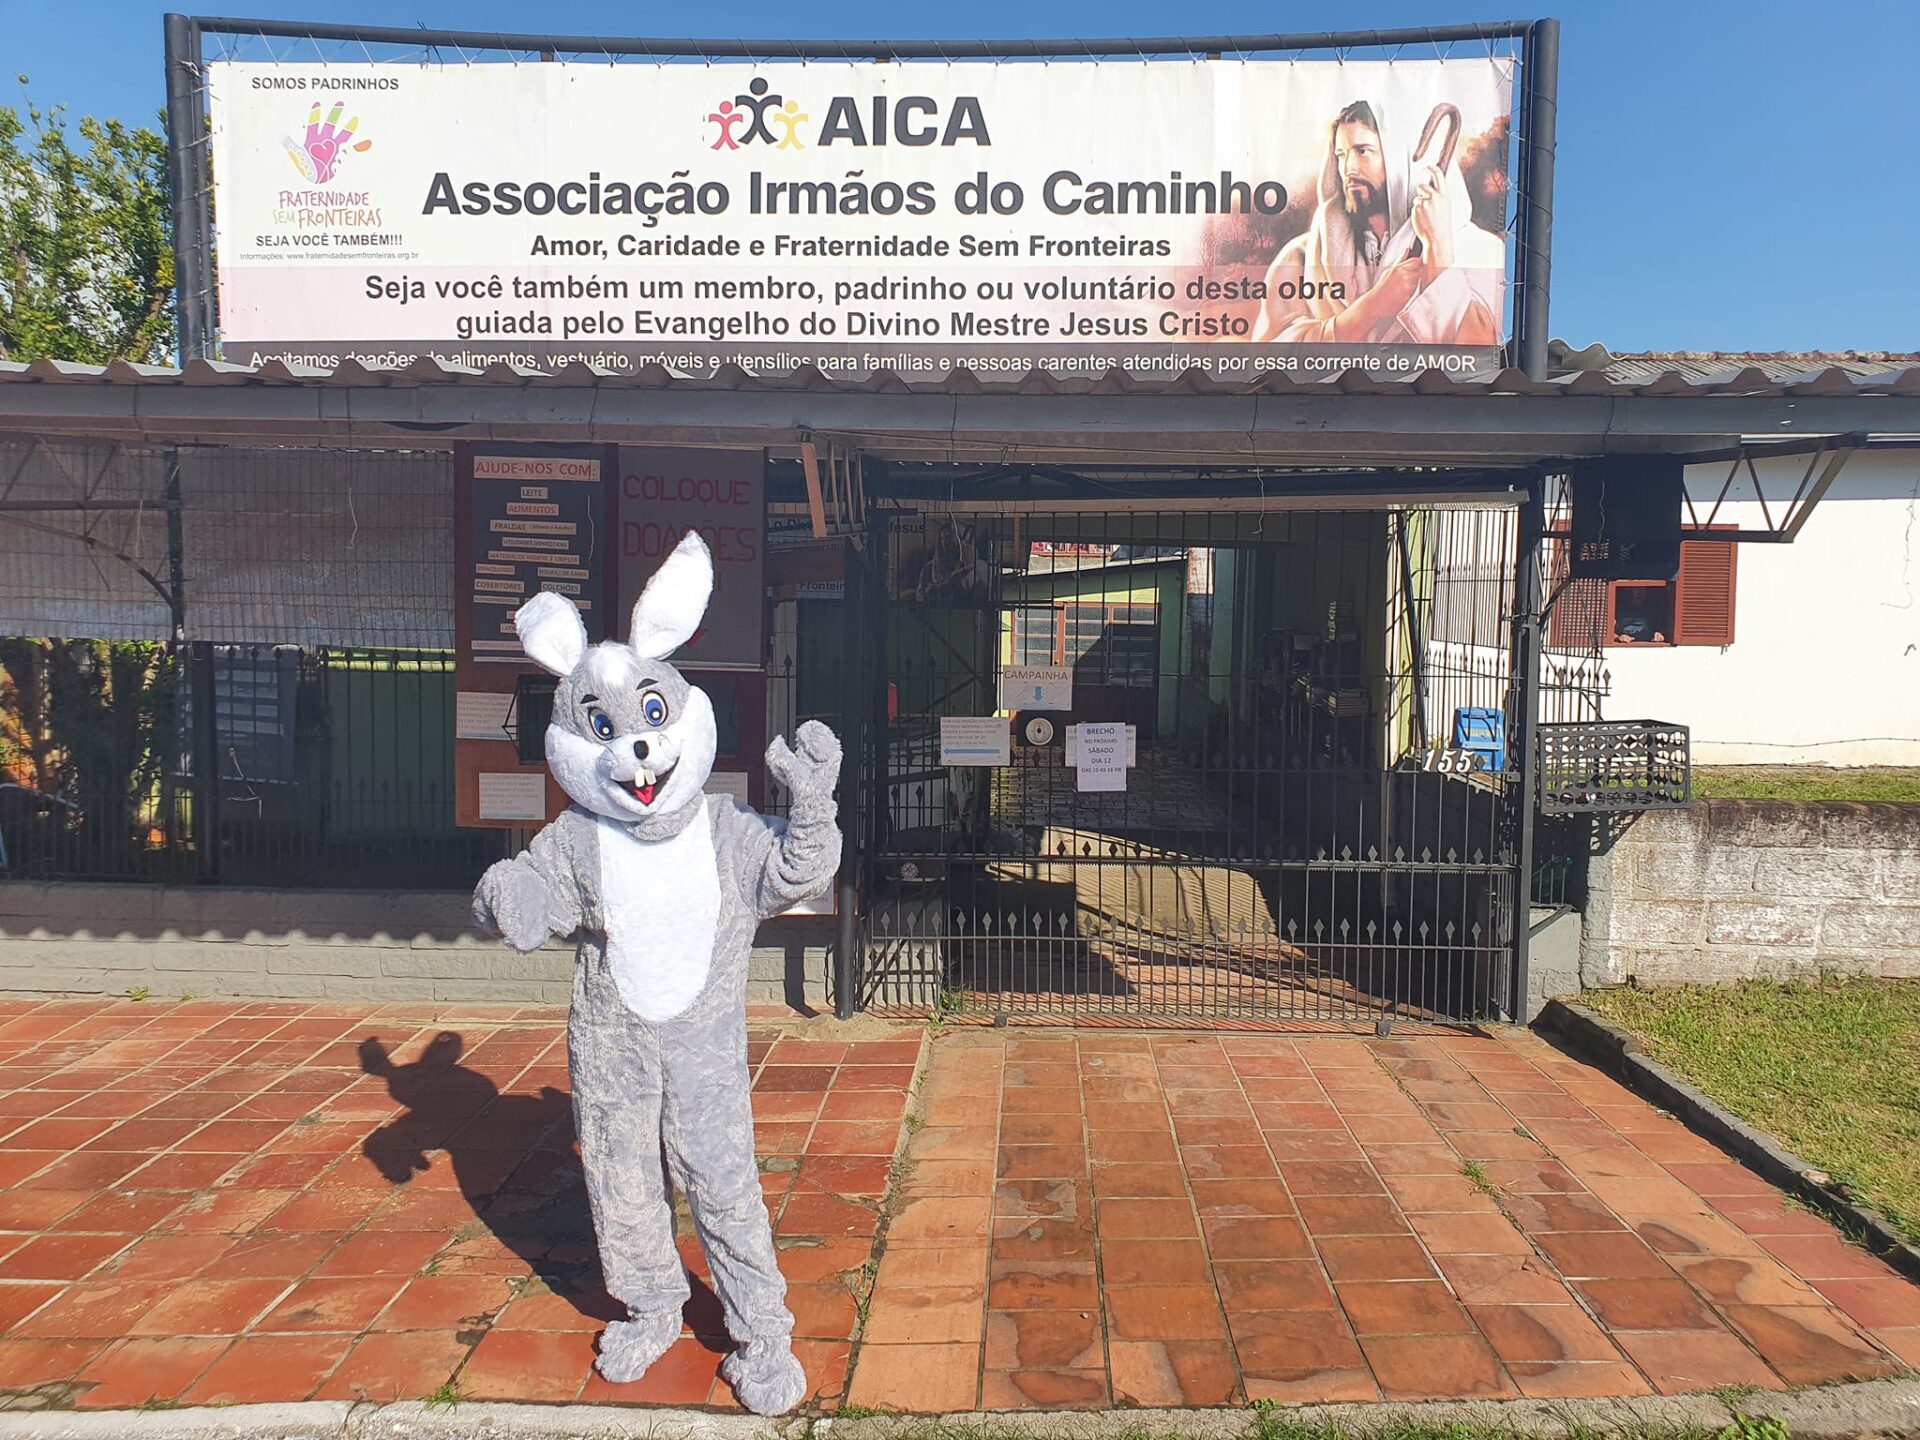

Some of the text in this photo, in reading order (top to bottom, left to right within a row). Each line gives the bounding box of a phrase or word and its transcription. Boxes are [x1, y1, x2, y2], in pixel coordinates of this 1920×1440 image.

[252, 77, 399, 90] SOMOS PADRINHOS
[817, 96, 991, 146] AICA
[279, 190, 370, 209] FRATERNIDADE
[421, 169, 1288, 228] Associação Irmãos do Caminho
[272, 207, 382, 229] SEM FRONTEIRAS
[256, 231, 403, 247] SEJA VOCÊ TAMBÉM!!!
[530, 234, 1171, 260] Amor, Caridade e Fraternidade Sem Fronteiras
[366, 274, 1346, 305] Seja você também um membro, padrinho ou voluntário desta obra
[456, 310, 1249, 341] guiada pelo Evangelho do Divino Mestre Jesus Cristo
[451, 351, 541, 370] alimentos,
[546, 351, 633, 371] vestuário,
[640, 352, 704, 369] móveis
[709, 355, 721, 369] e
[817, 356, 858, 371] para
[863, 353, 933, 371] famílias
[939, 357, 950, 371] e
[956, 357, 1032, 371] pessoas
[1038, 354, 1117, 370] carentes
[1122, 353, 1213, 371] atendidas
[1218, 356, 1248, 373] por
[1254, 356, 1298, 370] essa
[1304, 354, 1381, 371] corrente
[1386, 354, 1410, 371] de
[1414, 354, 1476, 372] AMOR
[476, 462, 553, 475] AJUDE-NOS
[522, 489, 543, 497] LEITE
[624, 475, 750, 506] COLOQUE
[508, 505, 557, 515] ALIMENTOS
[1004, 670, 1069, 681] CAMPAINHA
[1423, 749, 1475, 773] 155
